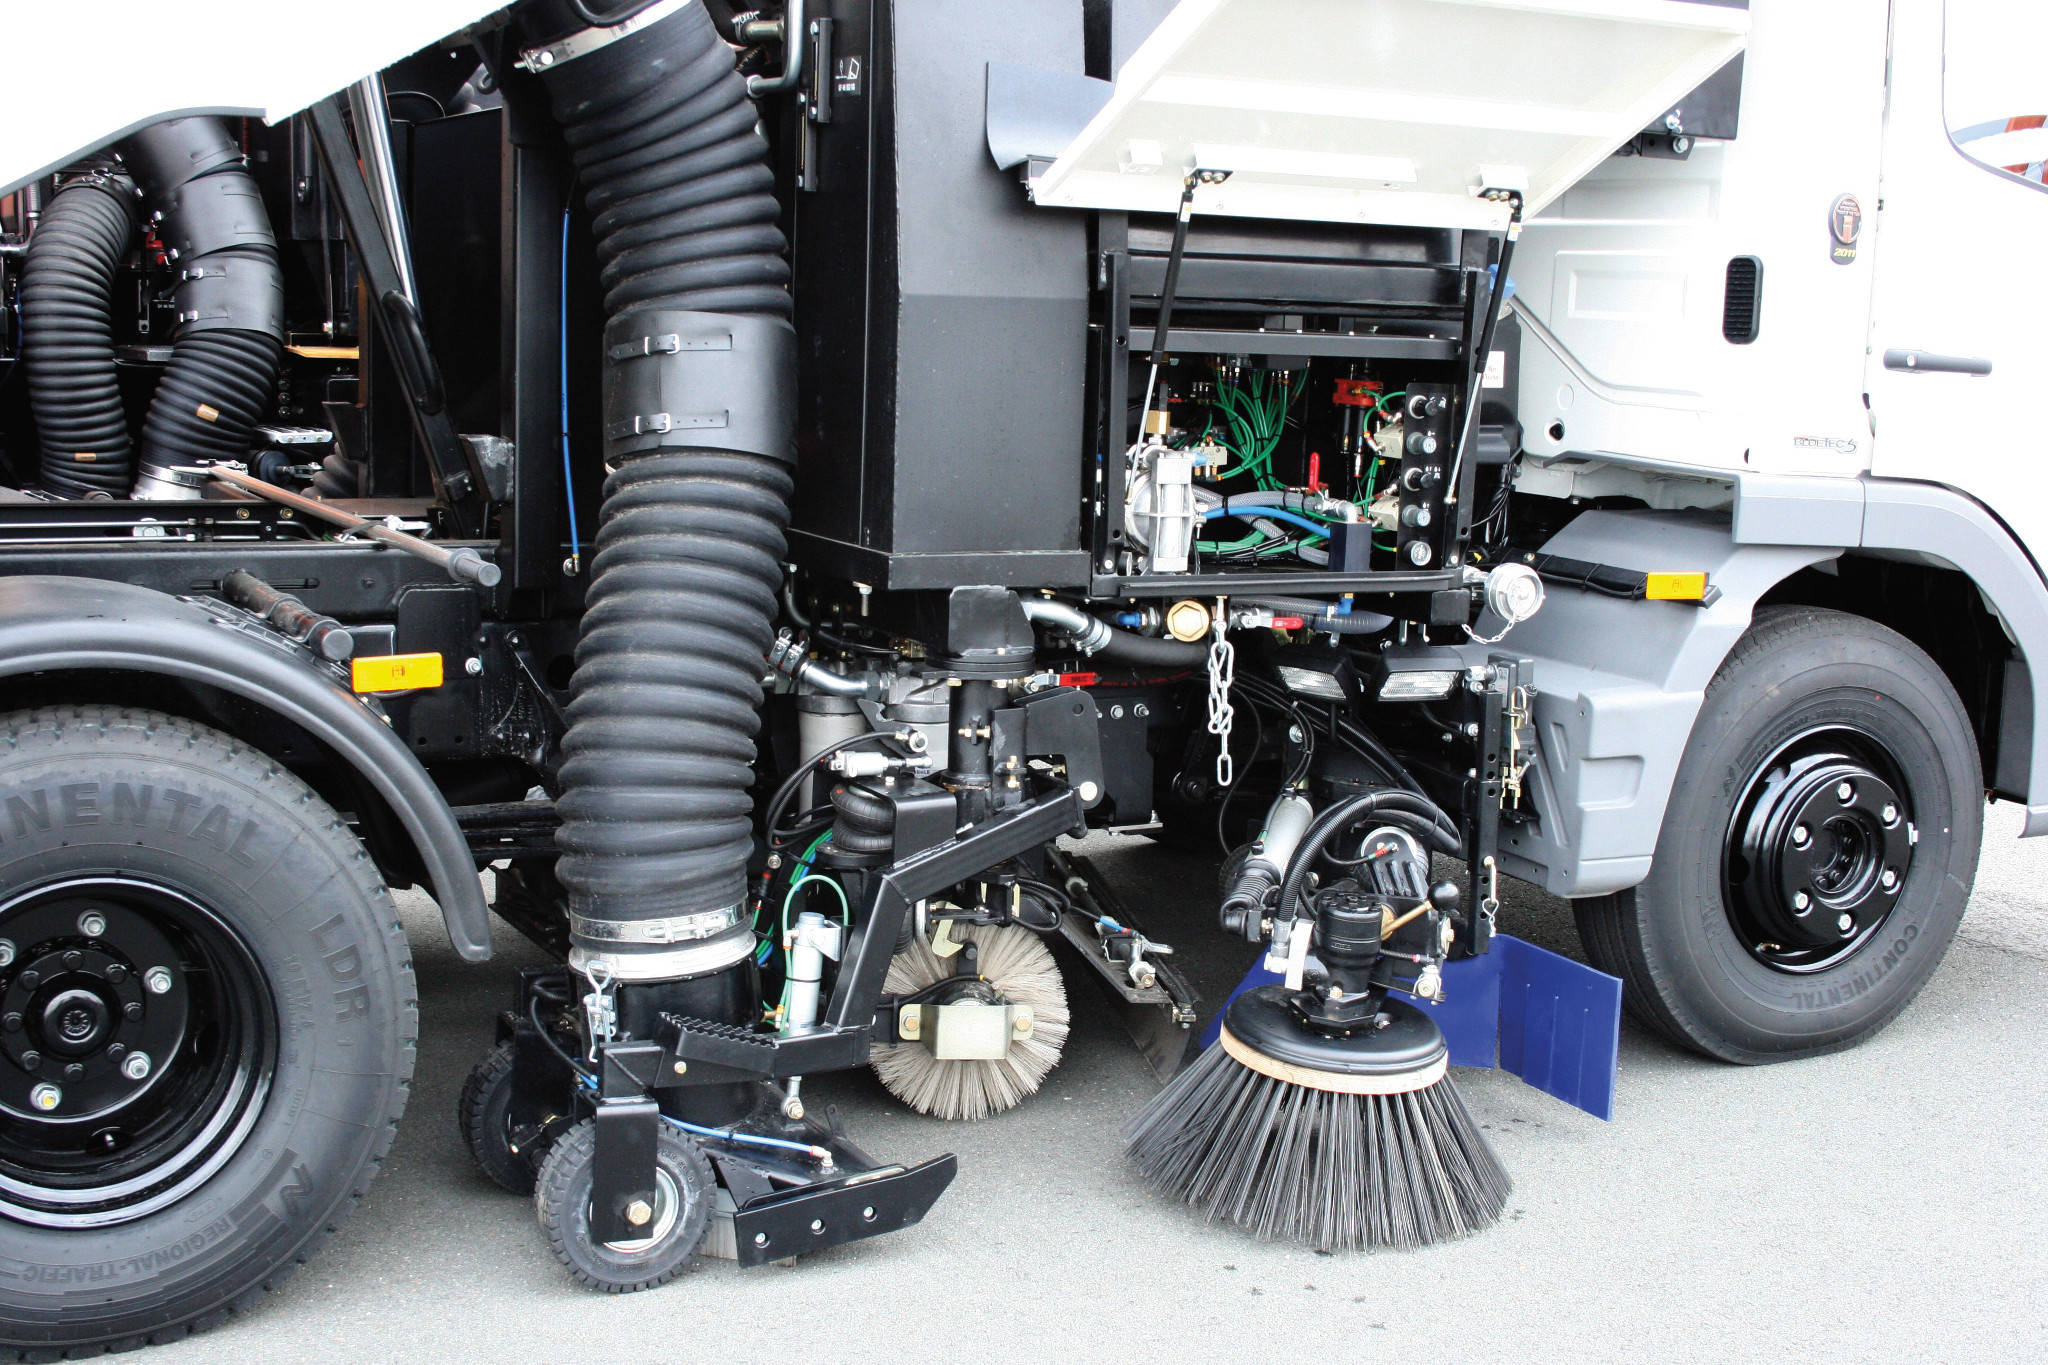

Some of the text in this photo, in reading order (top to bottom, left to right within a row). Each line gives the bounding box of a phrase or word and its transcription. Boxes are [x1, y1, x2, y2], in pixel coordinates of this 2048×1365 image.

[1833, 247, 1856, 257] 2011
[308, 912, 370, 1024] LDR
[1792, 924, 1919, 1010] CONTINENTAL
[22, 1213, 238, 1284] REGIONAL-TRAFFIC
